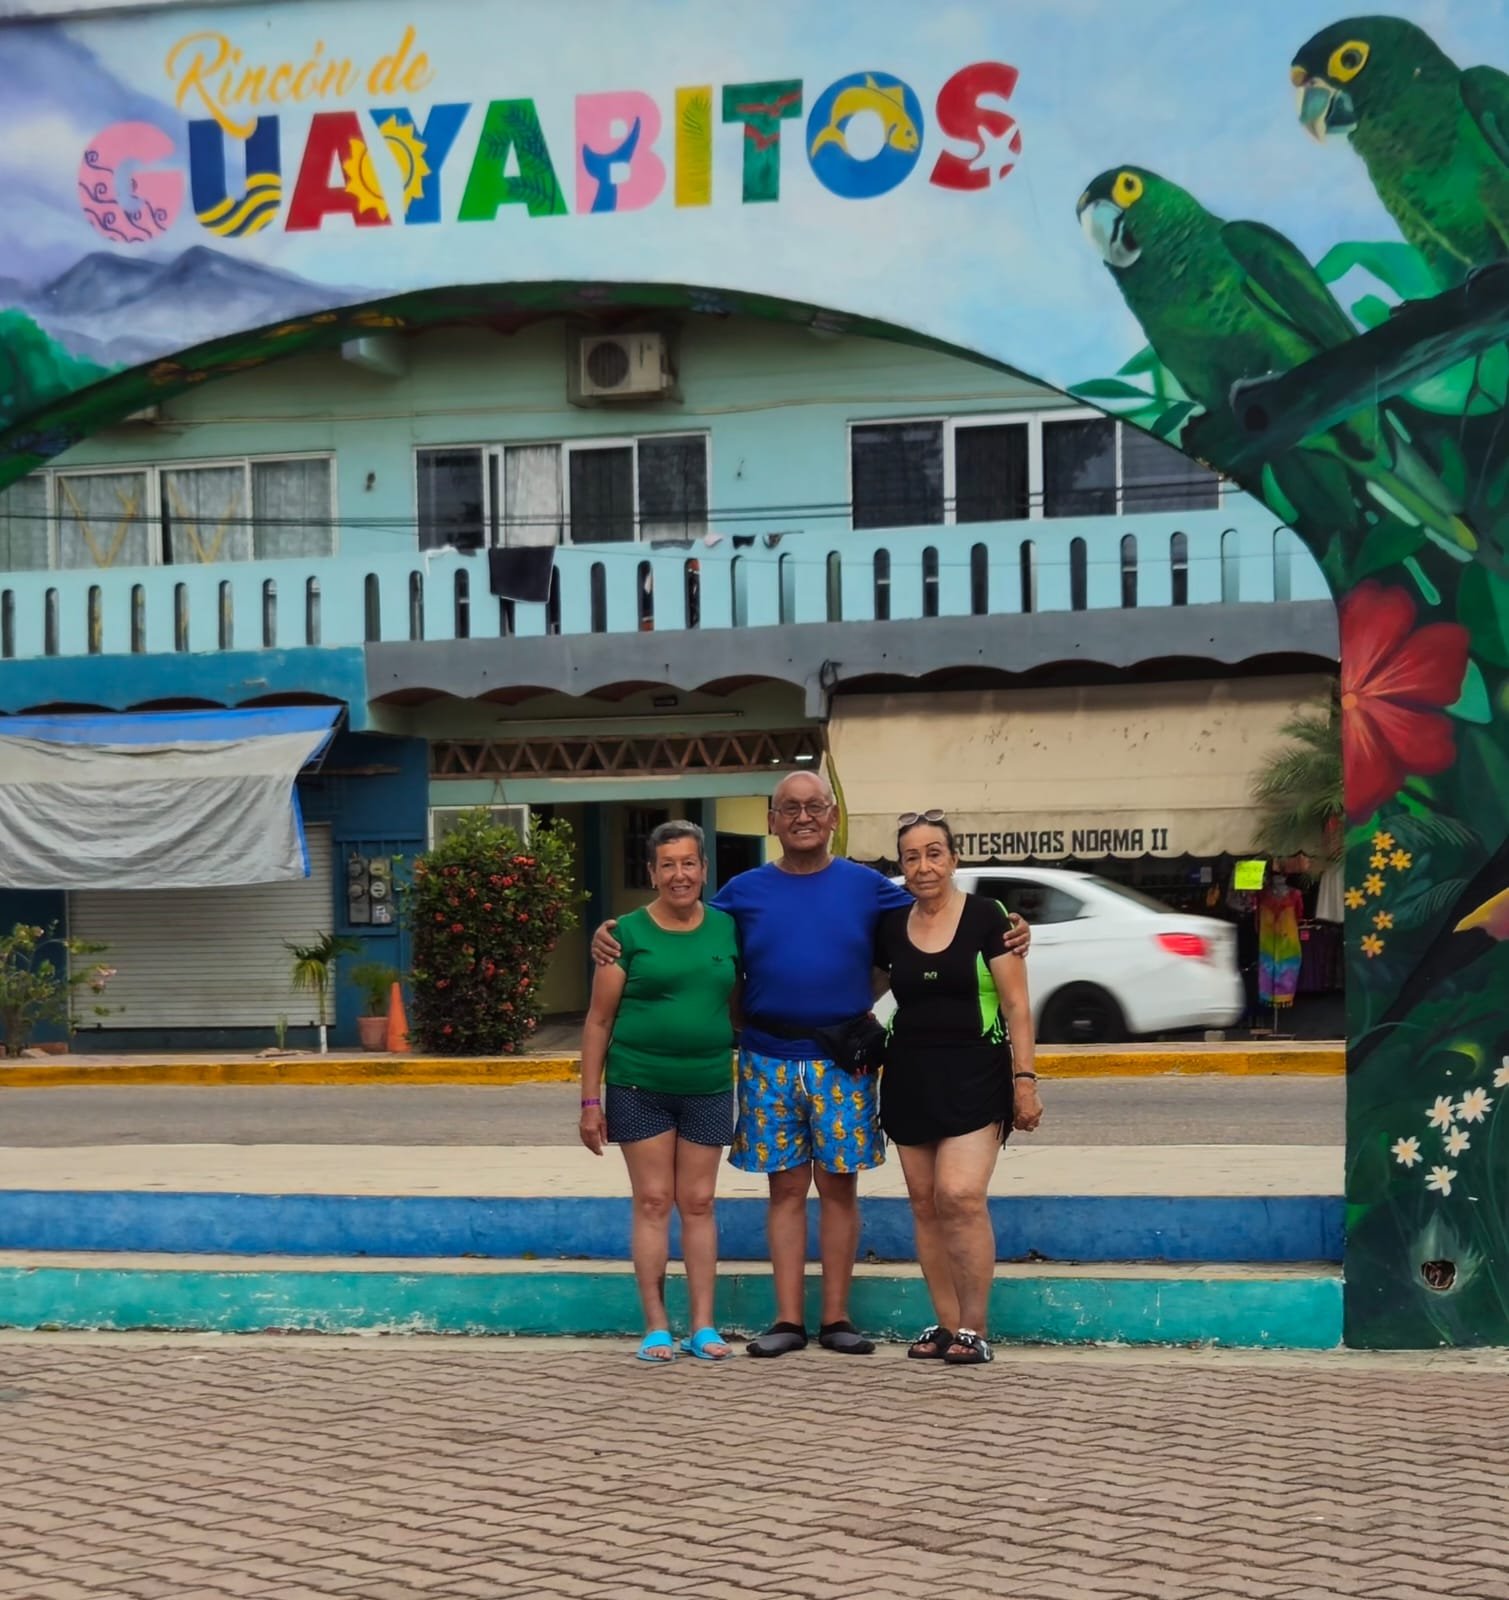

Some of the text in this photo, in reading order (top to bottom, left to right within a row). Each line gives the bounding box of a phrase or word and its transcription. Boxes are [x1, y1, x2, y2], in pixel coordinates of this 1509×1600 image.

[166, 25, 432, 139] Rincón de
[78, 61, 1022, 243] GUAYABITOS
[954, 828, 1168, 856] RTESANIAS NORMA II
